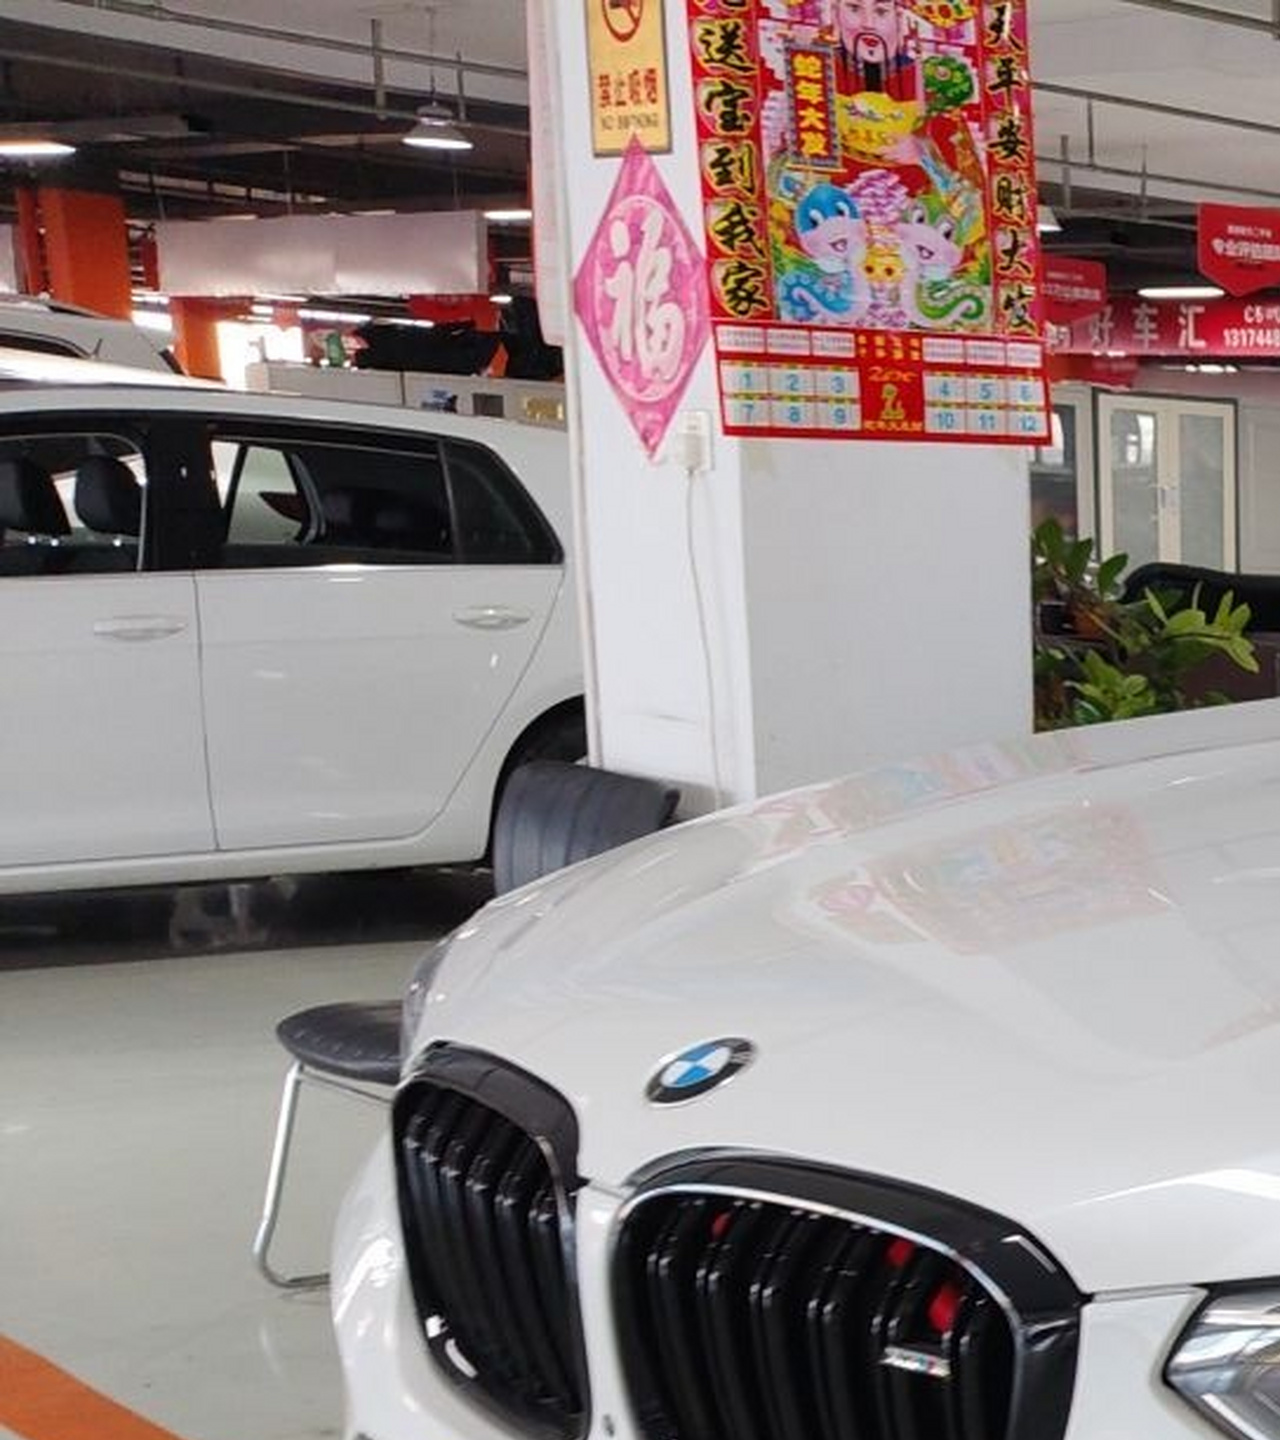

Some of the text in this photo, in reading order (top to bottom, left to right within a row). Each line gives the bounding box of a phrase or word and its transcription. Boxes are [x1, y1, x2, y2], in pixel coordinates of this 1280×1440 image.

[695, 0, 770, 316] 送宝到我家
[603, 205, 687, 383] 福
[742, 403, 754, 423] 7
[788, 405, 801, 423] 8
[832, 407, 847, 425] 9
[937, 412, 955, 429] 10
[978, 413, 994, 430] 11
[1020, 415, 1037, 432] 12
[786, 373, 800, 391] 2
[831, 376, 846, 393] 3
[938, 380, 951, 396] 4
[979, 382, 994, 399] 5
